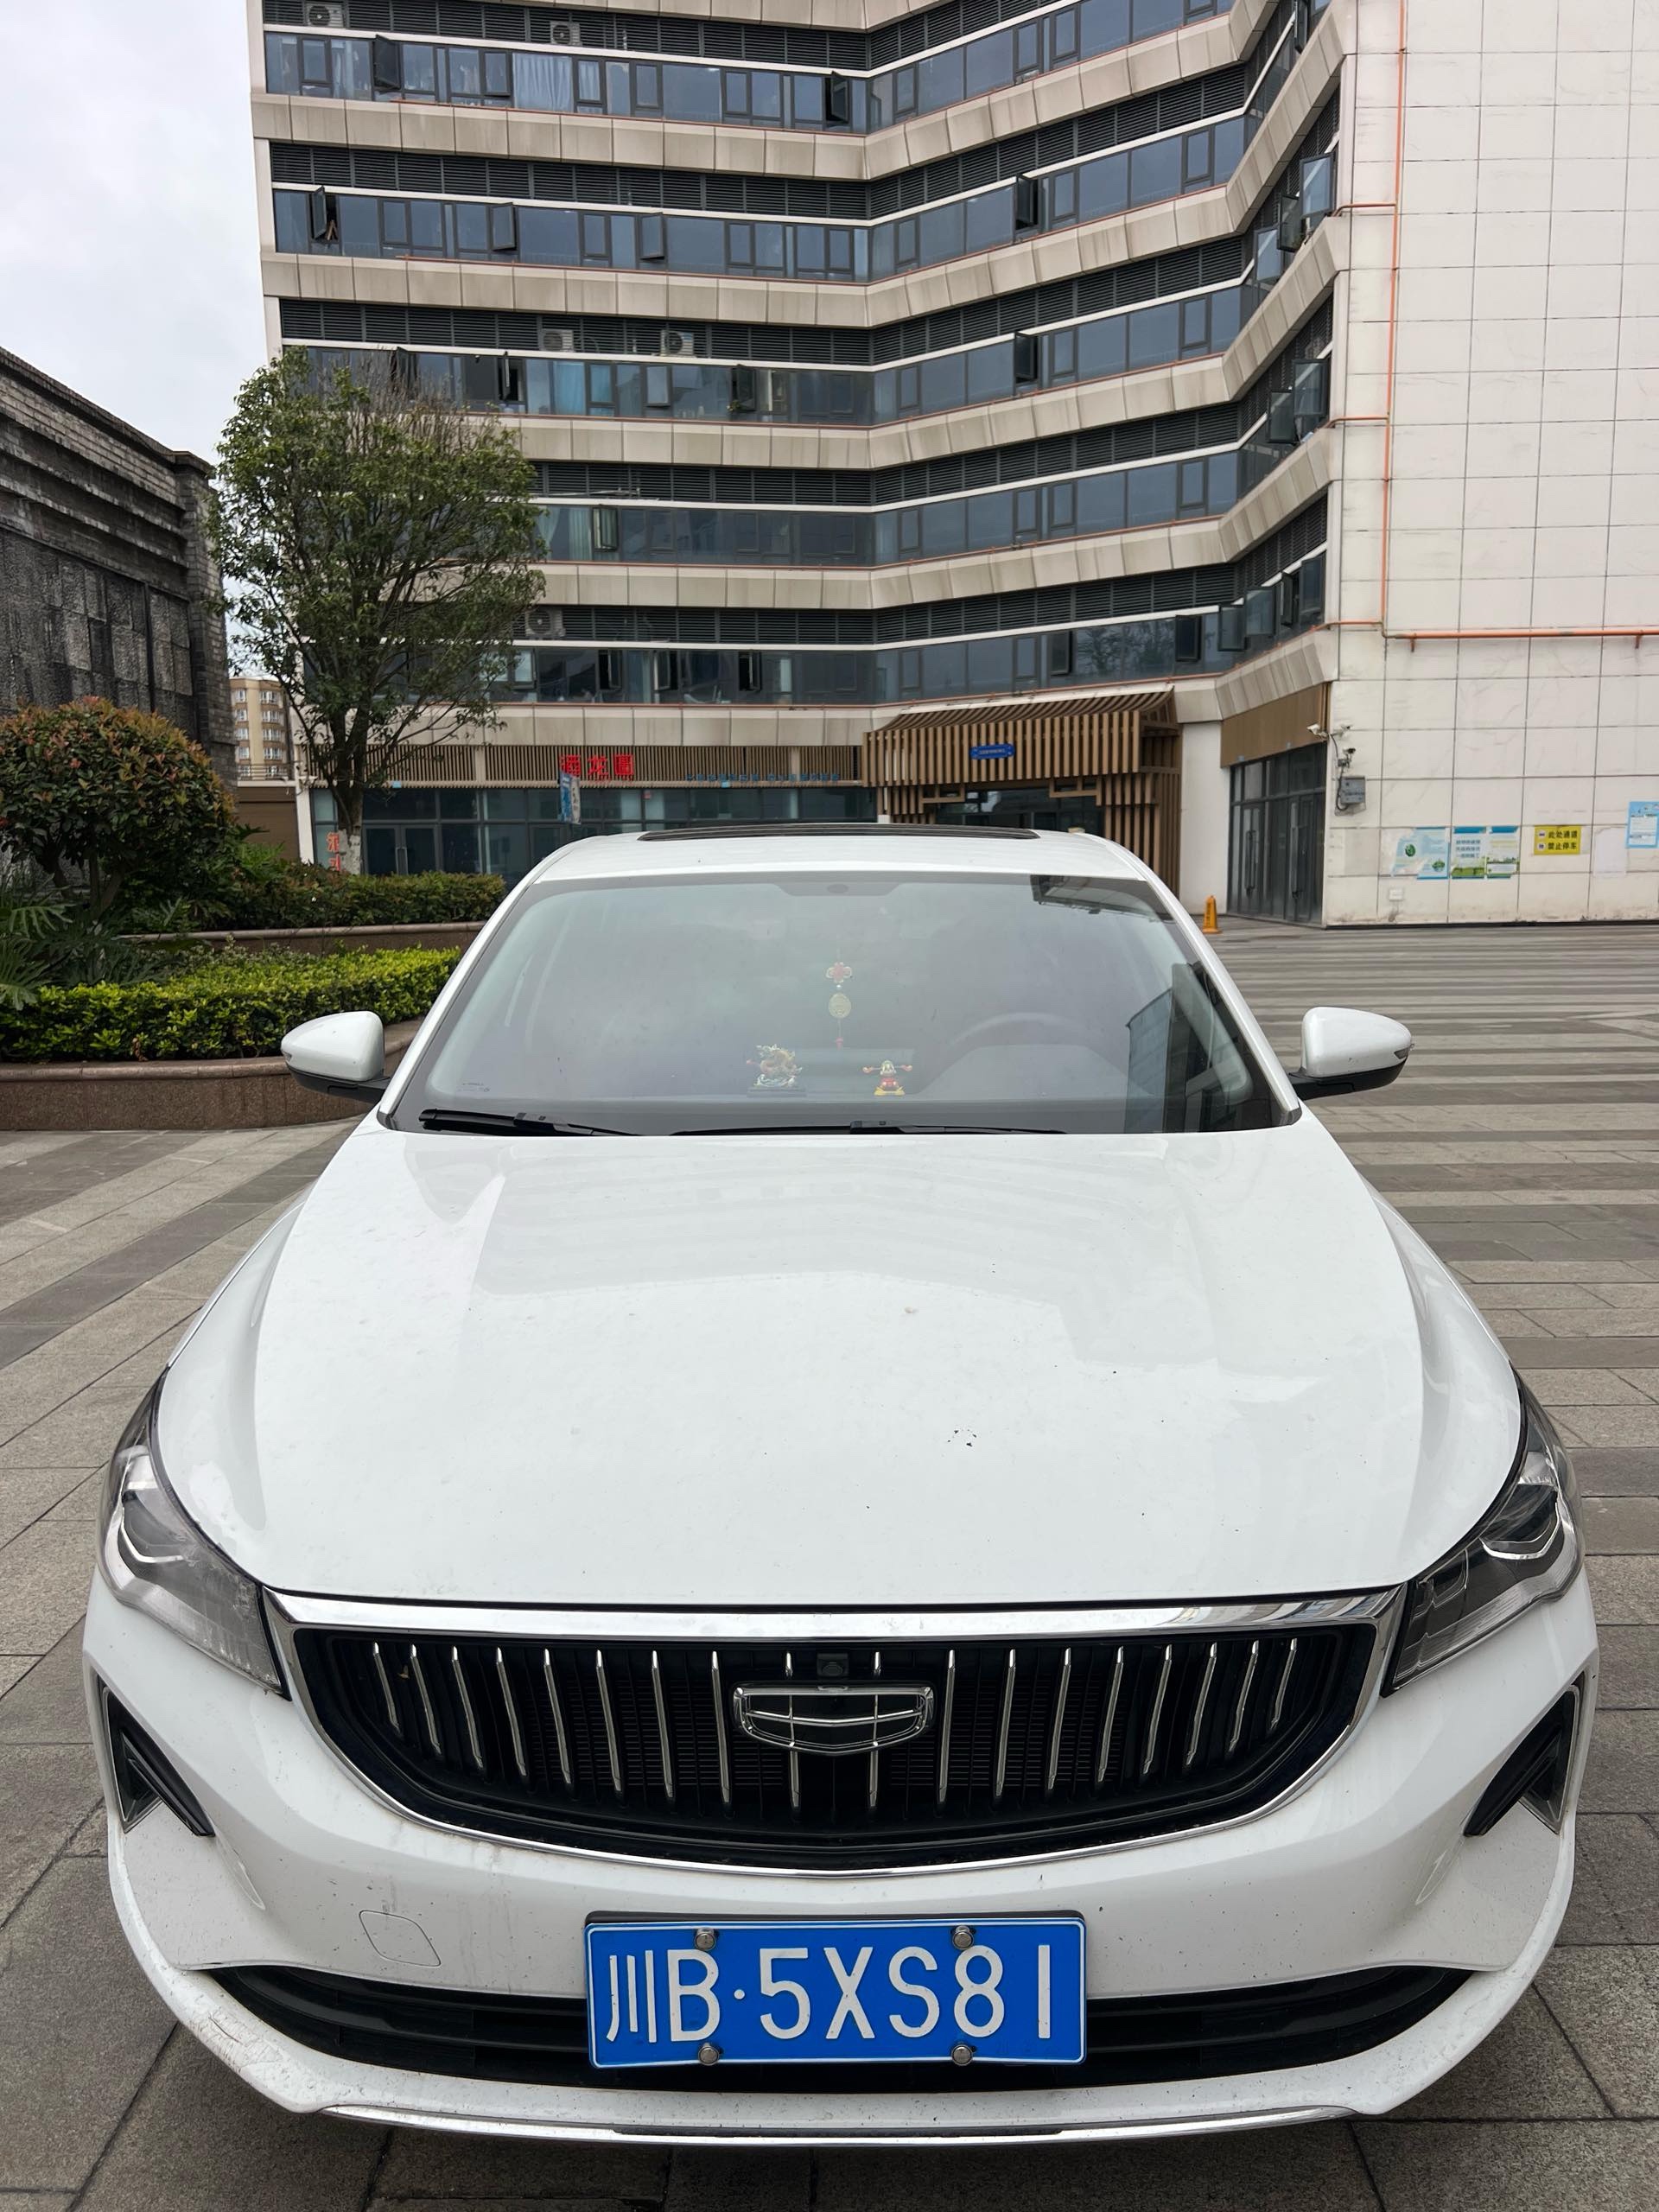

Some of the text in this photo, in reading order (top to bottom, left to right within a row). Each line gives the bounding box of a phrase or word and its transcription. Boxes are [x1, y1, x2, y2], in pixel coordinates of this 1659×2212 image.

[1548, 830, 1578, 839] 此处通道
[1548, 842, 1577, 850] 禁止停车
